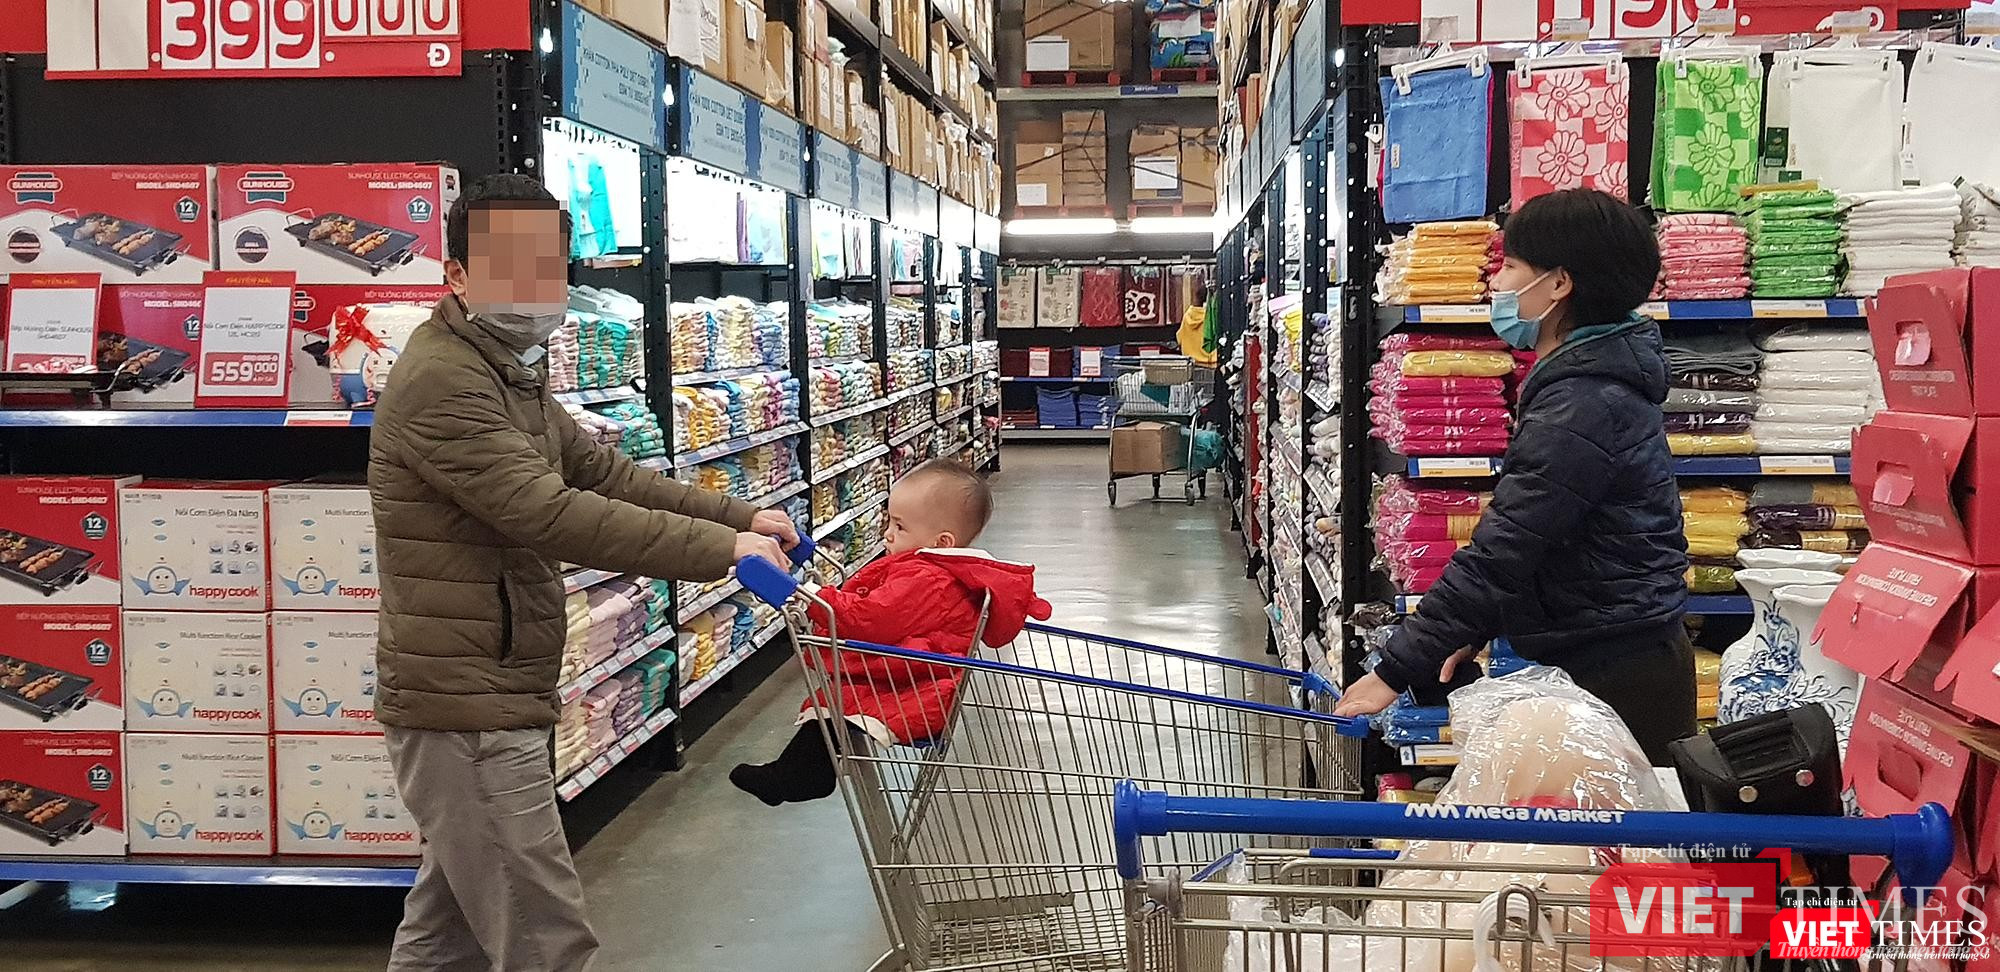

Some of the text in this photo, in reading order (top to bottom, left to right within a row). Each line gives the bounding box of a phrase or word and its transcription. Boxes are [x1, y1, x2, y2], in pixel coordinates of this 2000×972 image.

[12, 181, 59, 189] SUNHOUSE
[242, 181, 290, 189] SUNHOUSE
[179, 202, 194, 213] 12
[411, 201, 427, 213] 12
[86, 517, 102, 529] 12
[90, 644, 105, 656] 12
[91, 769, 107, 780] 12
